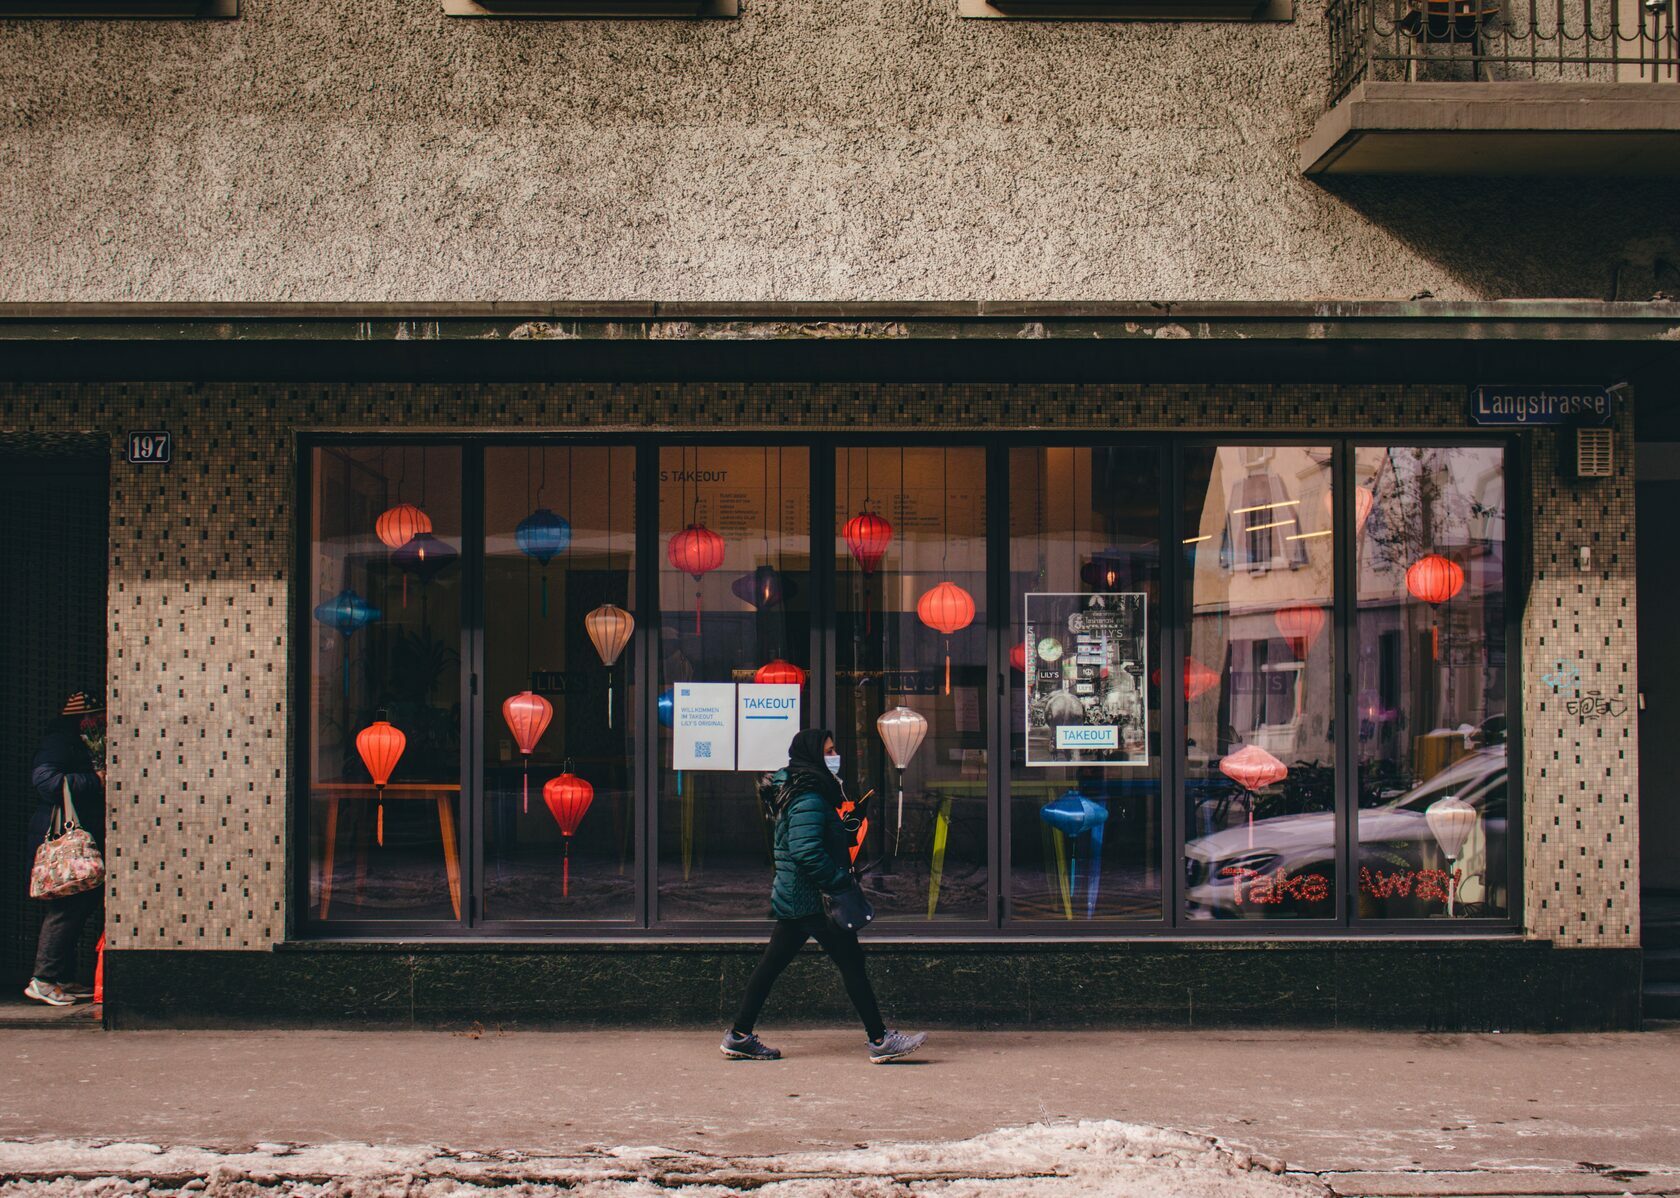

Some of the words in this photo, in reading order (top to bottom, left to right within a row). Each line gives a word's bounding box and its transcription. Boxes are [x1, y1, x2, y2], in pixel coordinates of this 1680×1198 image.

[1478, 387, 1605, 422] Langstrasse
[132, 436, 167, 459] 197
[671, 470, 728, 482] TAKEOUT
[1040, 671, 1060, 679] LILY'S
[743, 697, 797, 709] TAKEOUT
[1063, 729, 1112, 740] TAKEOUT
[1219, 866, 1329, 906] Take
